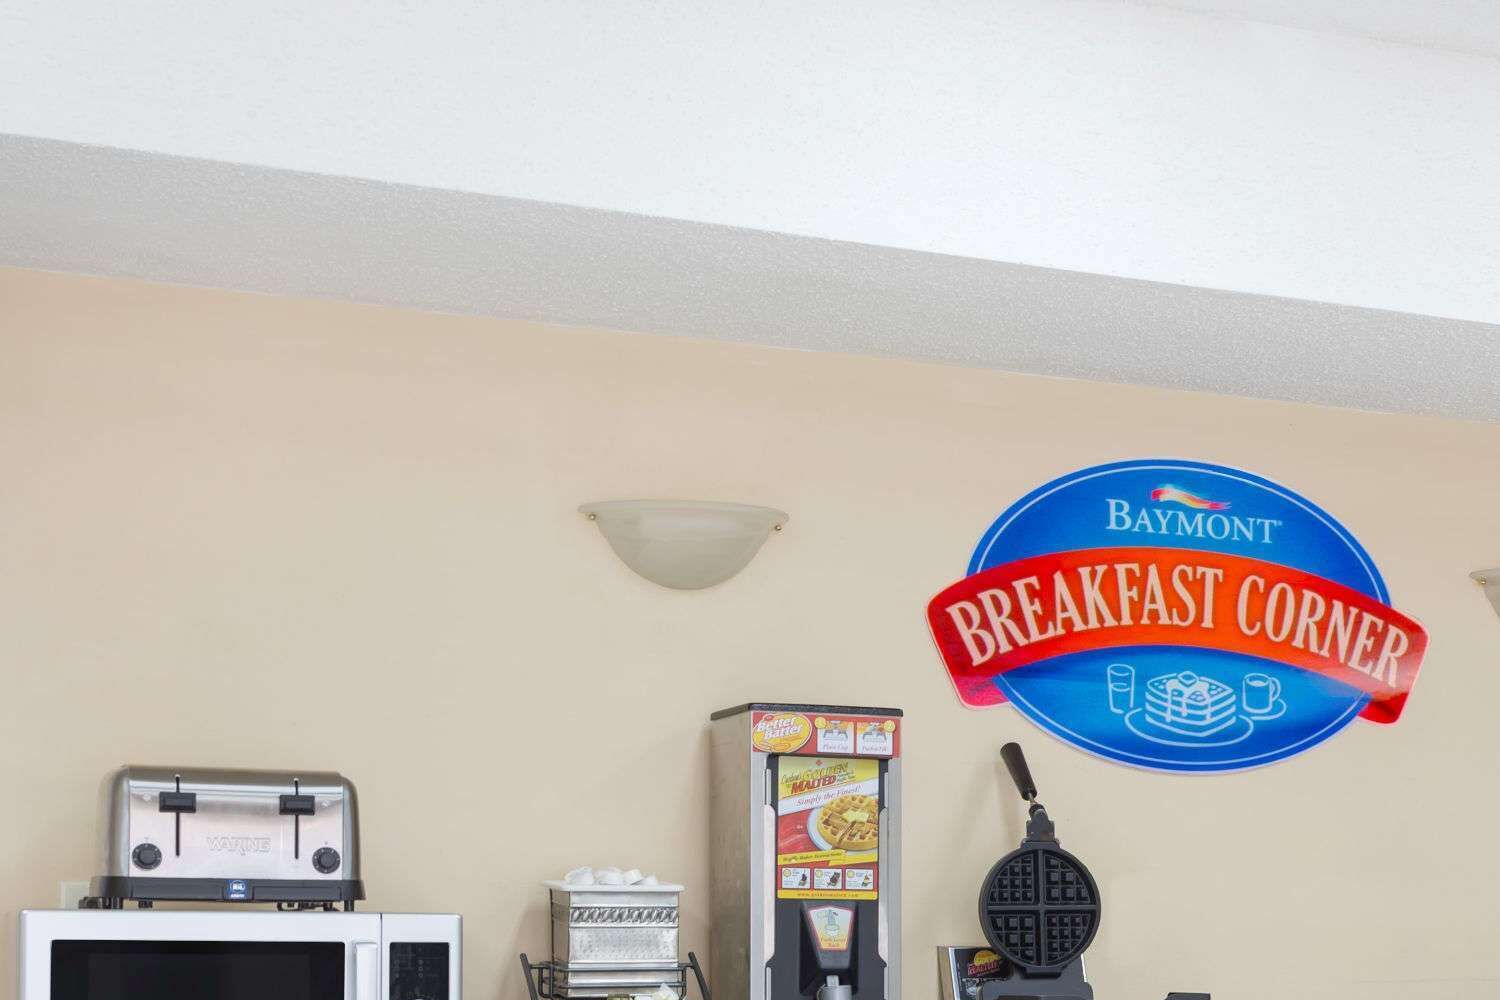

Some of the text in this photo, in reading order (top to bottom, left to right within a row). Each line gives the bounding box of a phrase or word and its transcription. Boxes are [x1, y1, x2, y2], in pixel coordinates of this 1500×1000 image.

[1105, 499, 1275, 544] BAYMONT
[945, 563, 1410, 689] BREAKFAST CORNER
[791, 775, 837, 794] MALTED
